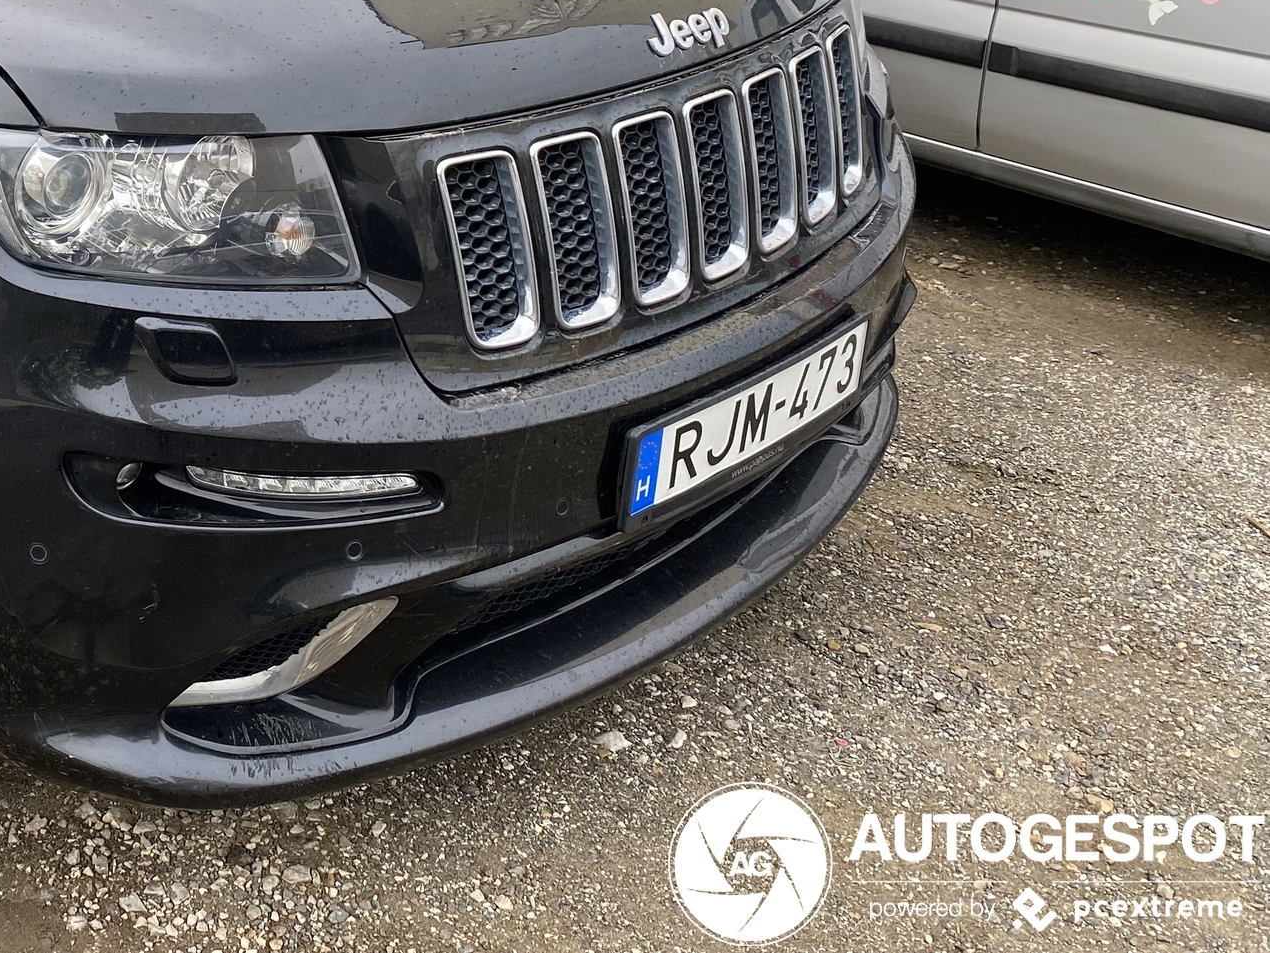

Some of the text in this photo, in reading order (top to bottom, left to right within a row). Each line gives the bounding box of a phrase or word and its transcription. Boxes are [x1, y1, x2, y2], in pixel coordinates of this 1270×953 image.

[647, 7, 730, 57] Jeep
[668, 333, 858, 489] RJM-473
[635, 475, 651, 501] H
